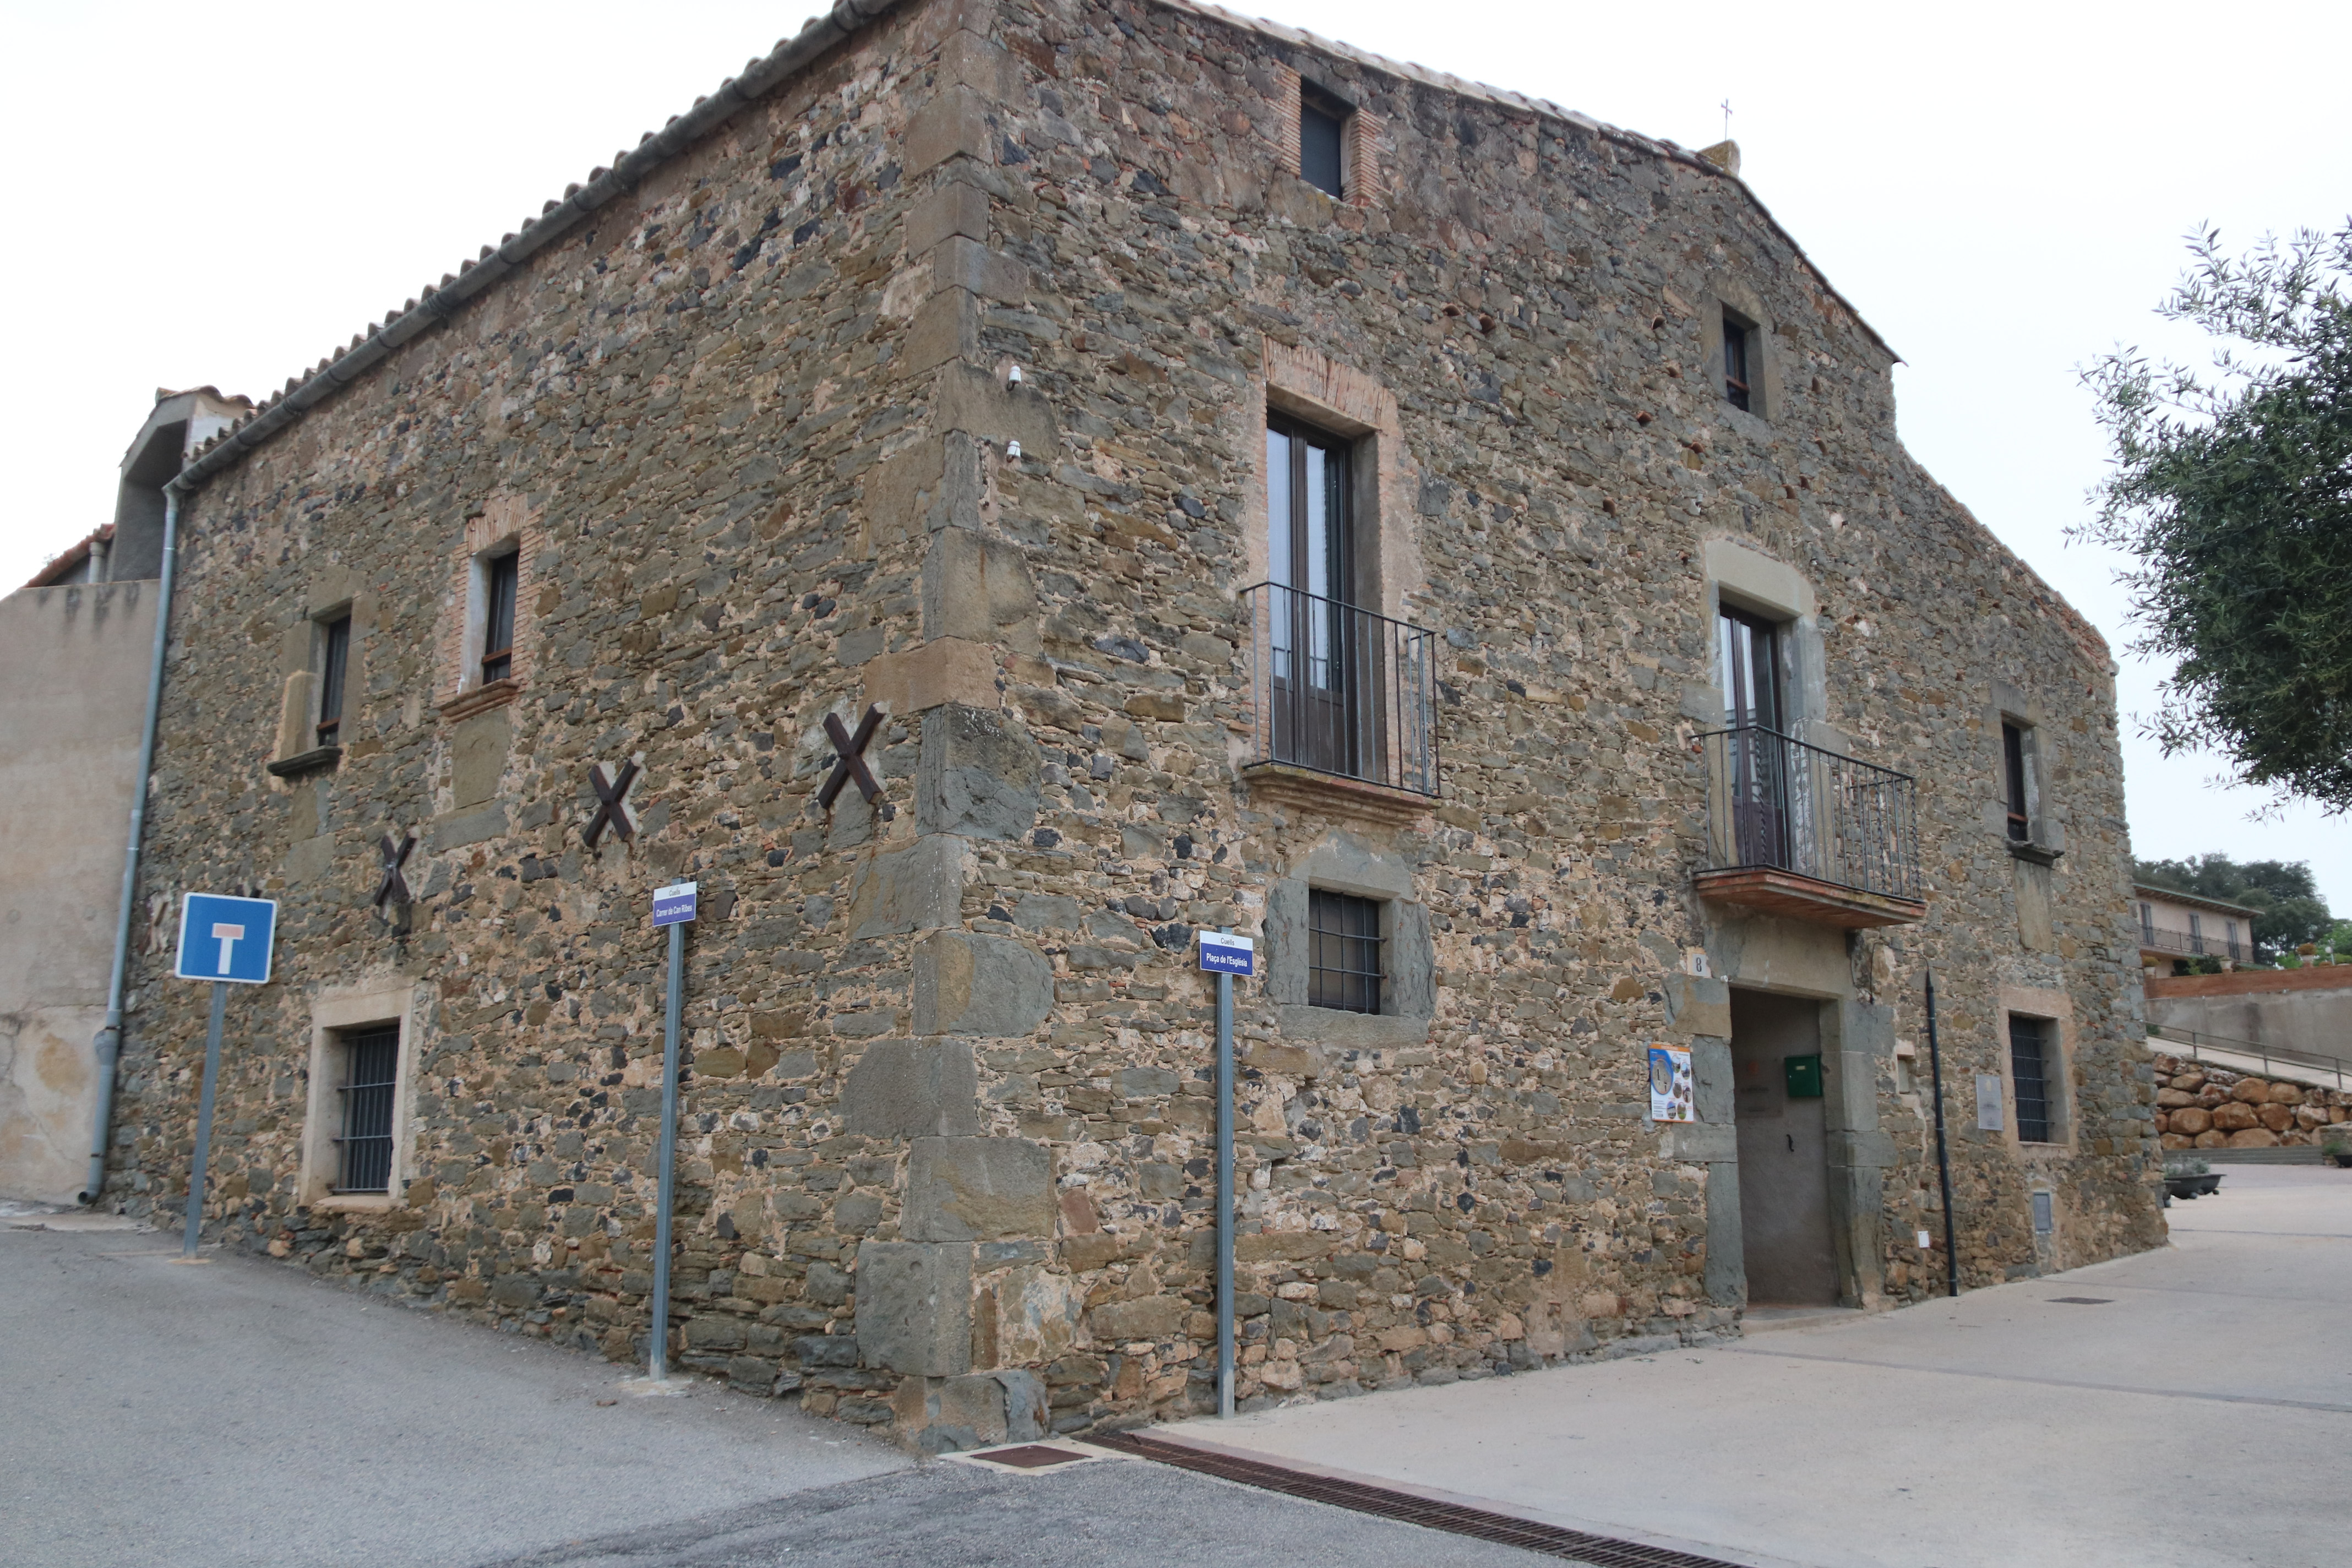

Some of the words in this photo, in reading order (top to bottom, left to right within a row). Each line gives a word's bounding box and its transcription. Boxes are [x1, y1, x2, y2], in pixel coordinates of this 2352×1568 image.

[656, 909, 667, 917] Carrer
[668, 907, 673, 915] de
[682, 904, 692, 912] Ribes
[1221, 938, 1235, 946] Cuells
[1206, 952, 1219, 964] Plaça
[1220, 955, 1226, 964] de
[1227, 956, 1248, 967] l'Església
[1696, 957, 1702, 972] 8
